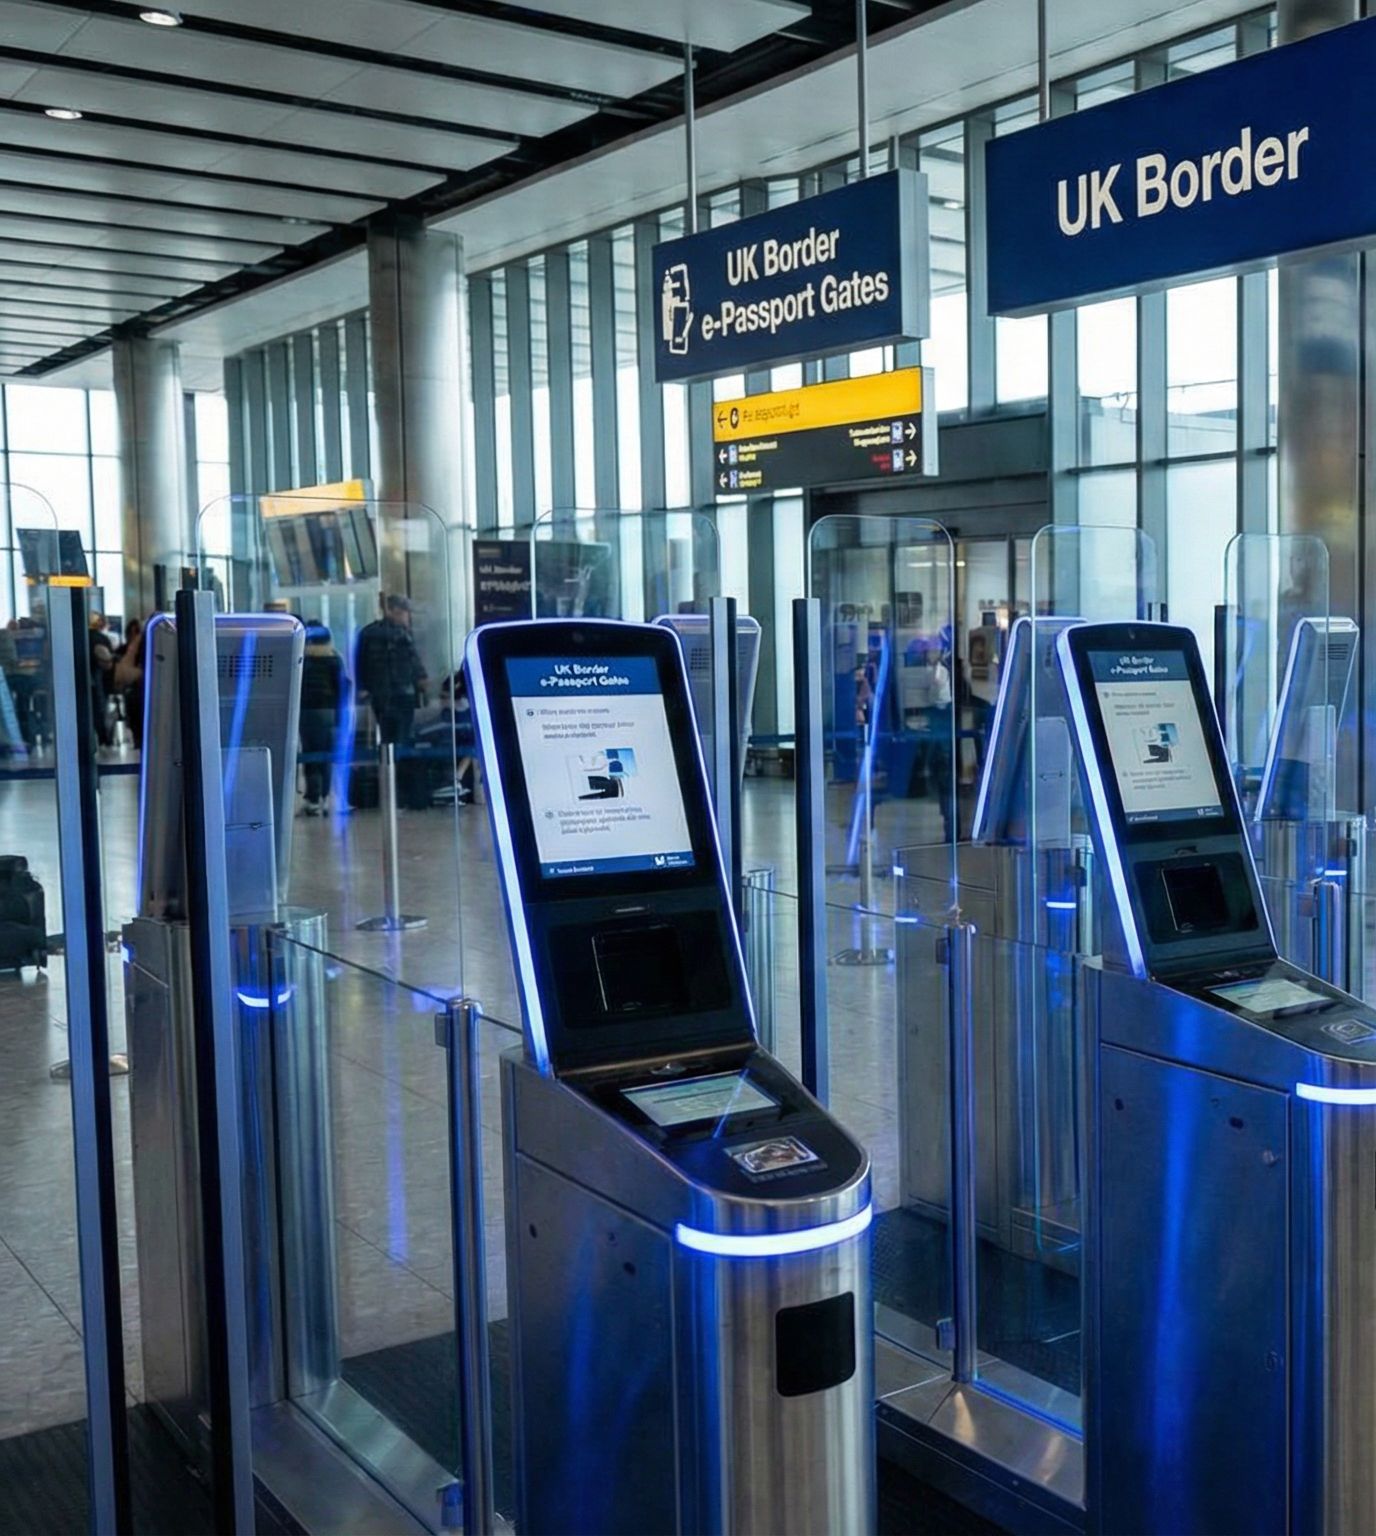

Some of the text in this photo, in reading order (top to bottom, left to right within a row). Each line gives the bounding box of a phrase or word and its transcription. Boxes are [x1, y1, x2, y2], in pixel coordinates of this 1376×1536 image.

[1057, 126, 1309, 236] UK Border
[727, 227, 840, 286] UK Border
[701, 271, 889, 340] e-Passport Gates
